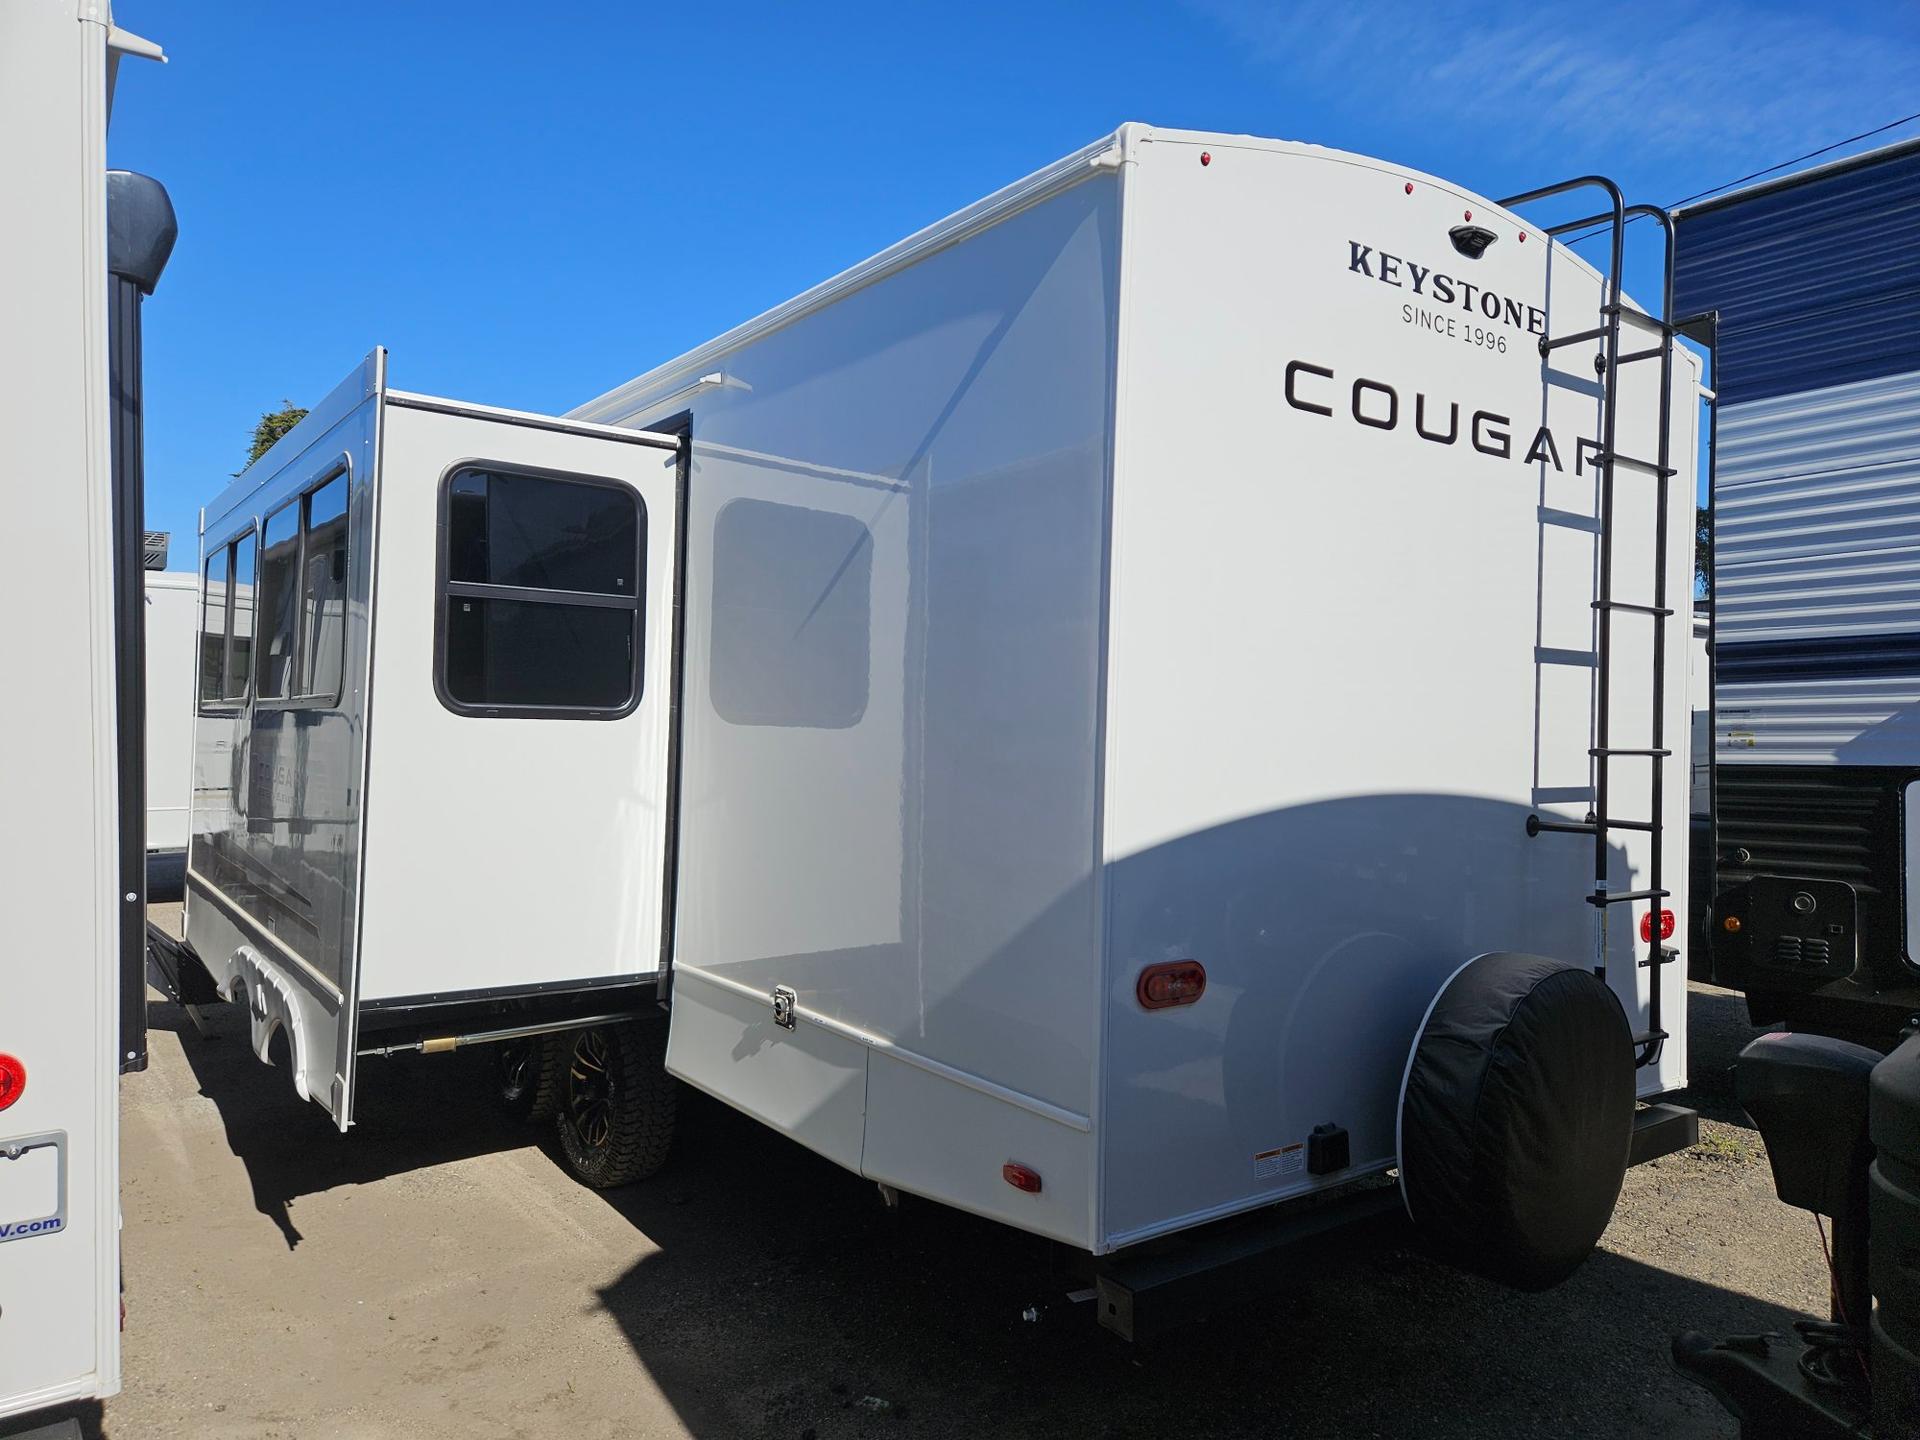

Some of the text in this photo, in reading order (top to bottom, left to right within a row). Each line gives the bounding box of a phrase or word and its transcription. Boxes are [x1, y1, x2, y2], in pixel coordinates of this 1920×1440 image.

[1348, 240, 1547, 336] KEYSTONE
[1402, 304, 1507, 354] SINCE 1996
